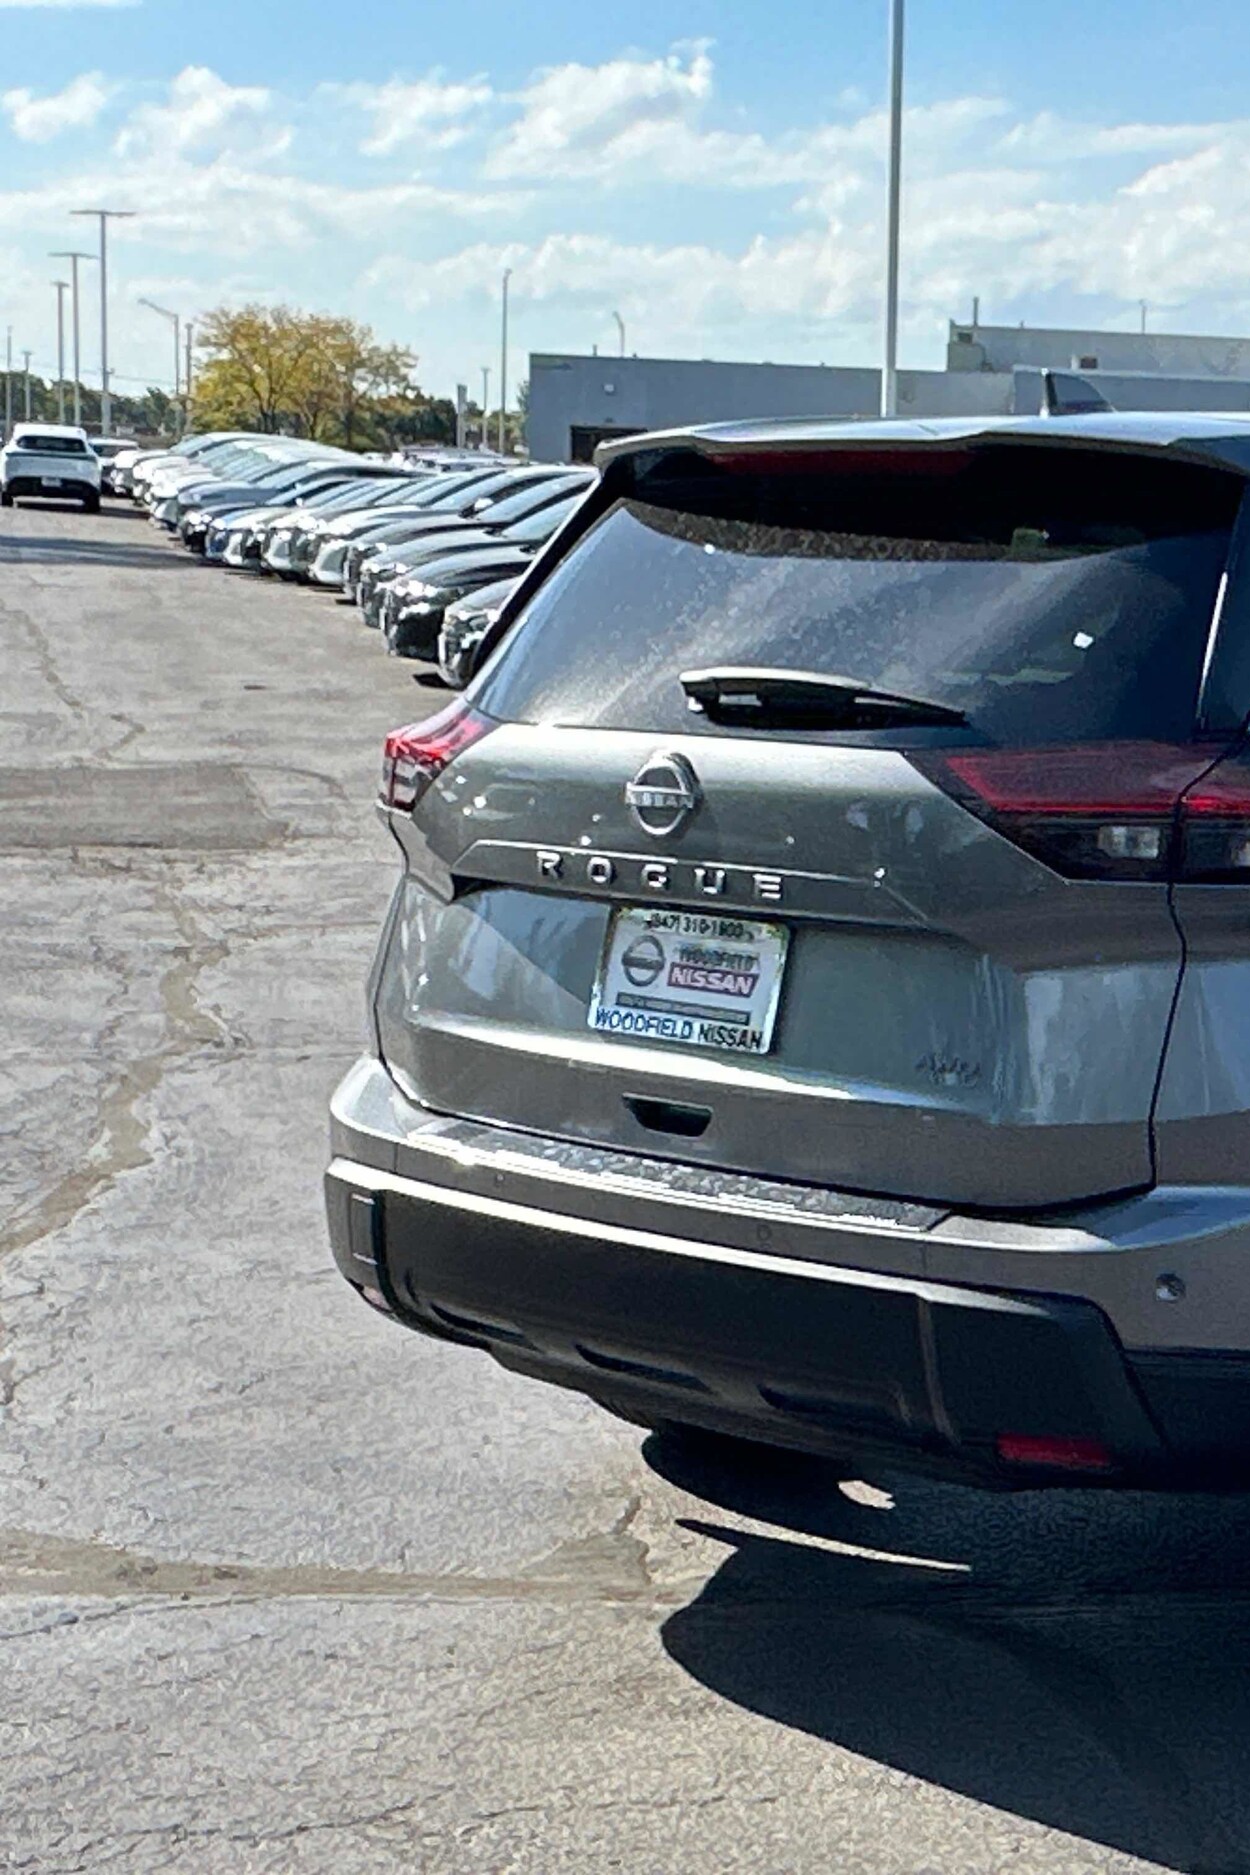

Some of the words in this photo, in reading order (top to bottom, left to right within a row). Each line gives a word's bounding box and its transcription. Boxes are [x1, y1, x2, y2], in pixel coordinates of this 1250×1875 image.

[536, 851, 783, 900] ROGUE
[671, 966, 754, 995] NISSAN
[595, 1007, 693, 1040] WOODFIELD
[699, 1023, 763, 1049] NISSAN
